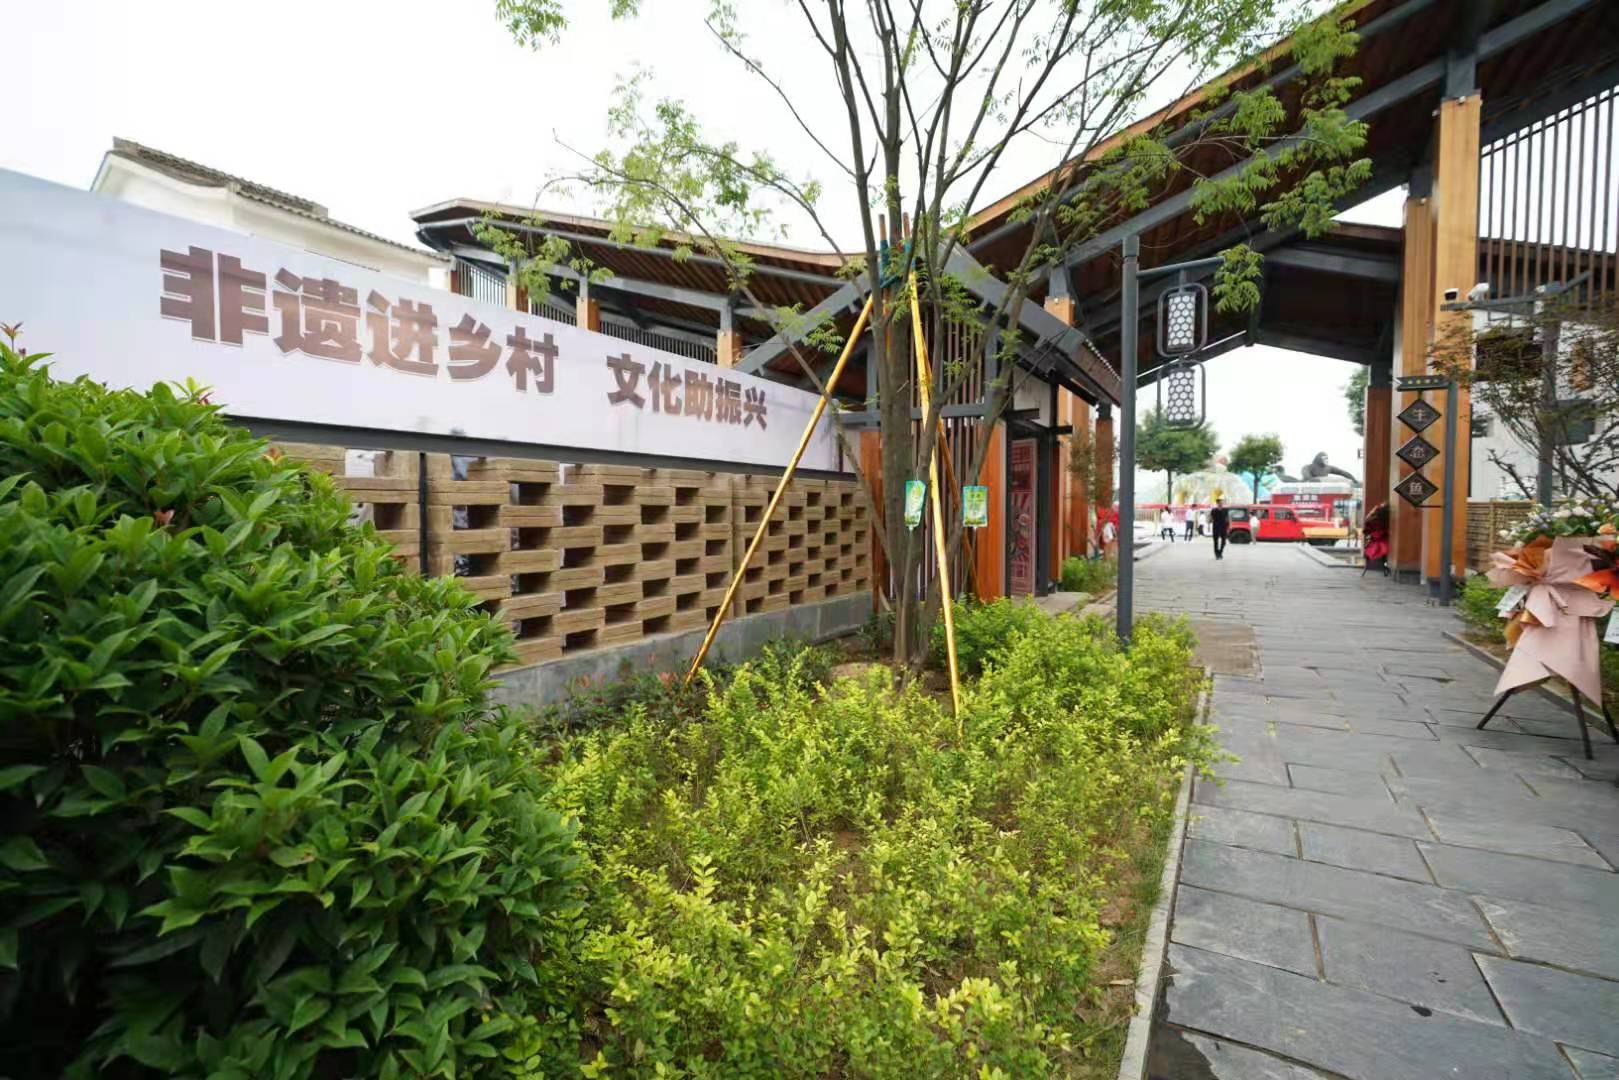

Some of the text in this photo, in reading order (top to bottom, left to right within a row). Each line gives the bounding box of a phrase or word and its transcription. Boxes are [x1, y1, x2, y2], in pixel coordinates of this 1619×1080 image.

[160, 245, 767, 431] 非遗进乡村 文化助振兴
